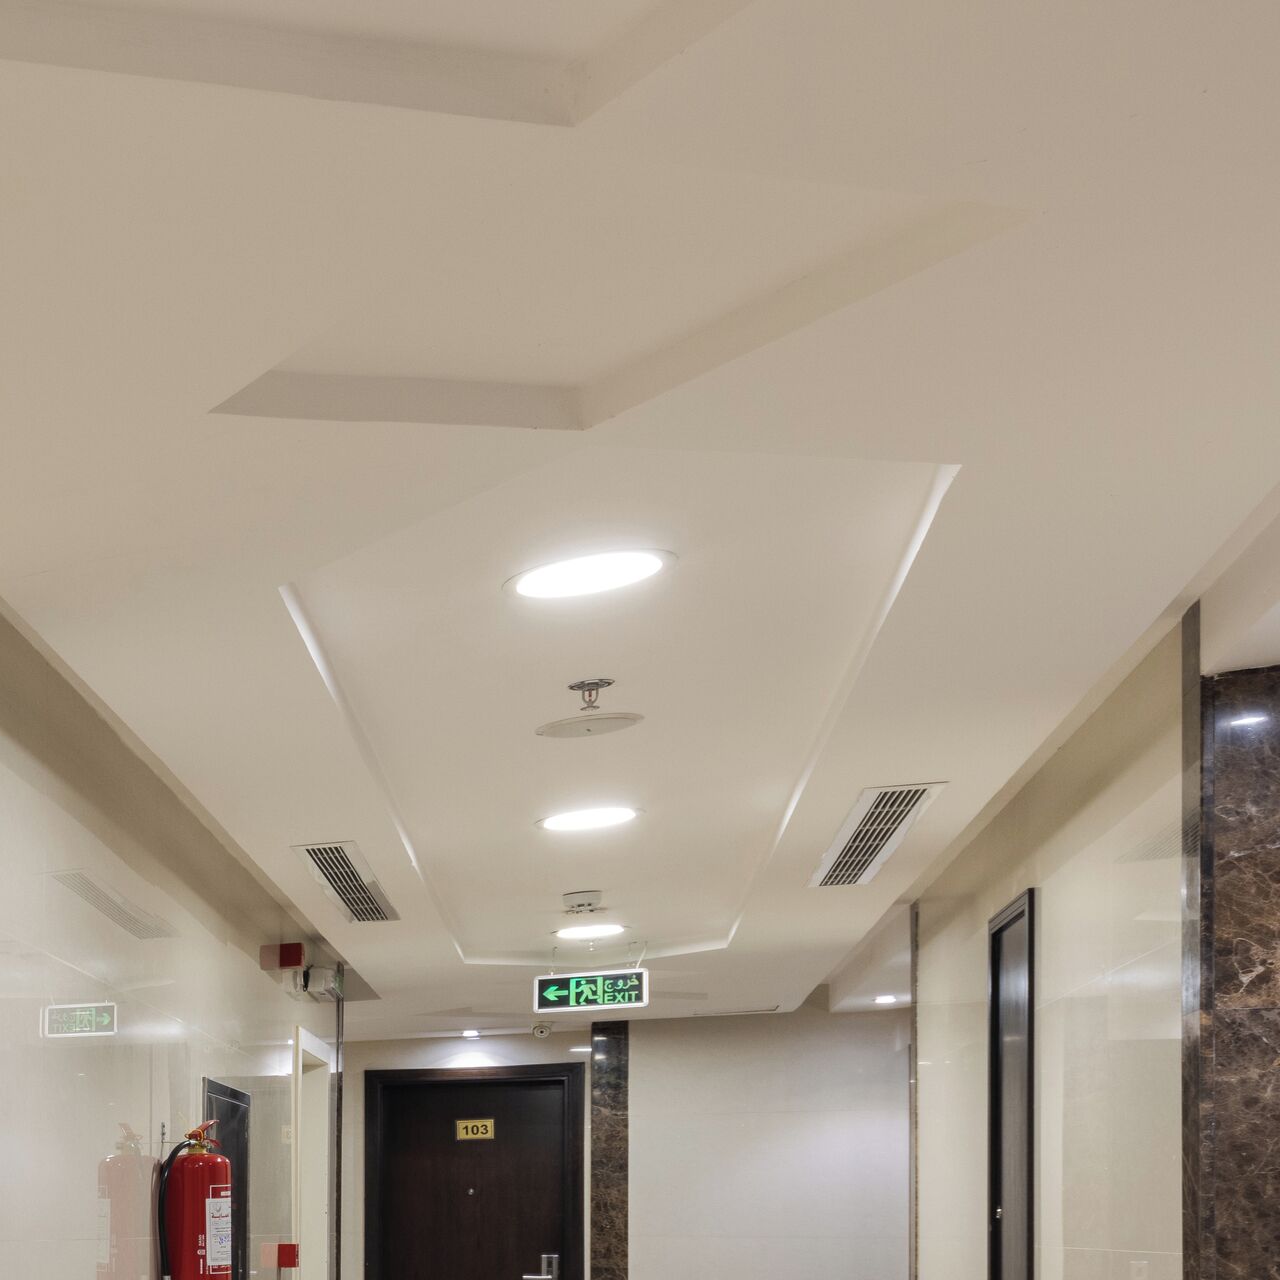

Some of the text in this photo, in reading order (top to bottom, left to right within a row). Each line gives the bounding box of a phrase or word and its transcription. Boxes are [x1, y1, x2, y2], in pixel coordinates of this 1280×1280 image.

[604, 975, 639, 991] خروج
[604, 991, 638, 1004] EXIT
[463, 1124, 488, 1135] 103
